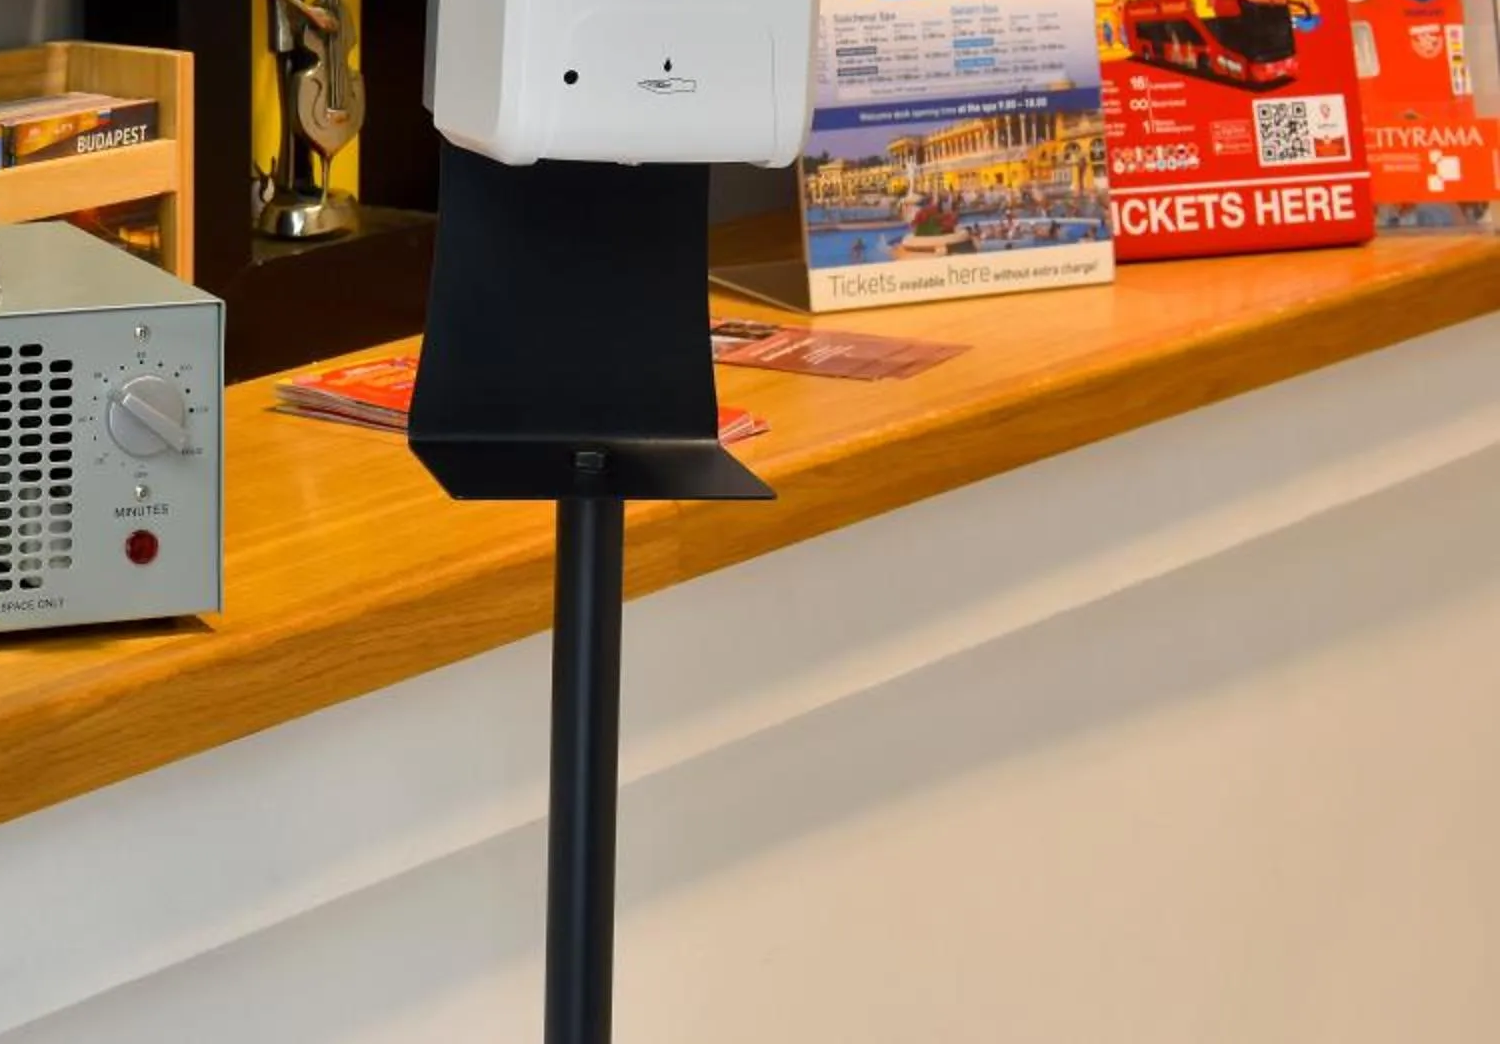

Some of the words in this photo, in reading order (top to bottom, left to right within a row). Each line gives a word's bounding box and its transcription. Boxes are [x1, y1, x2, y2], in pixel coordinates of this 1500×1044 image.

[77, 124, 148, 154] BUDAPEST
[1111, 191, 1246, 237] ICKETS
[1254, 184, 1356, 227] HERE
[827, 272, 897, 298] Tickets
[947, 262, 992, 287] here
[114, 504, 169, 518] MINUTES
[0, 601, 35, 614] SPACE
[37, 597, 65, 609] ONLY
